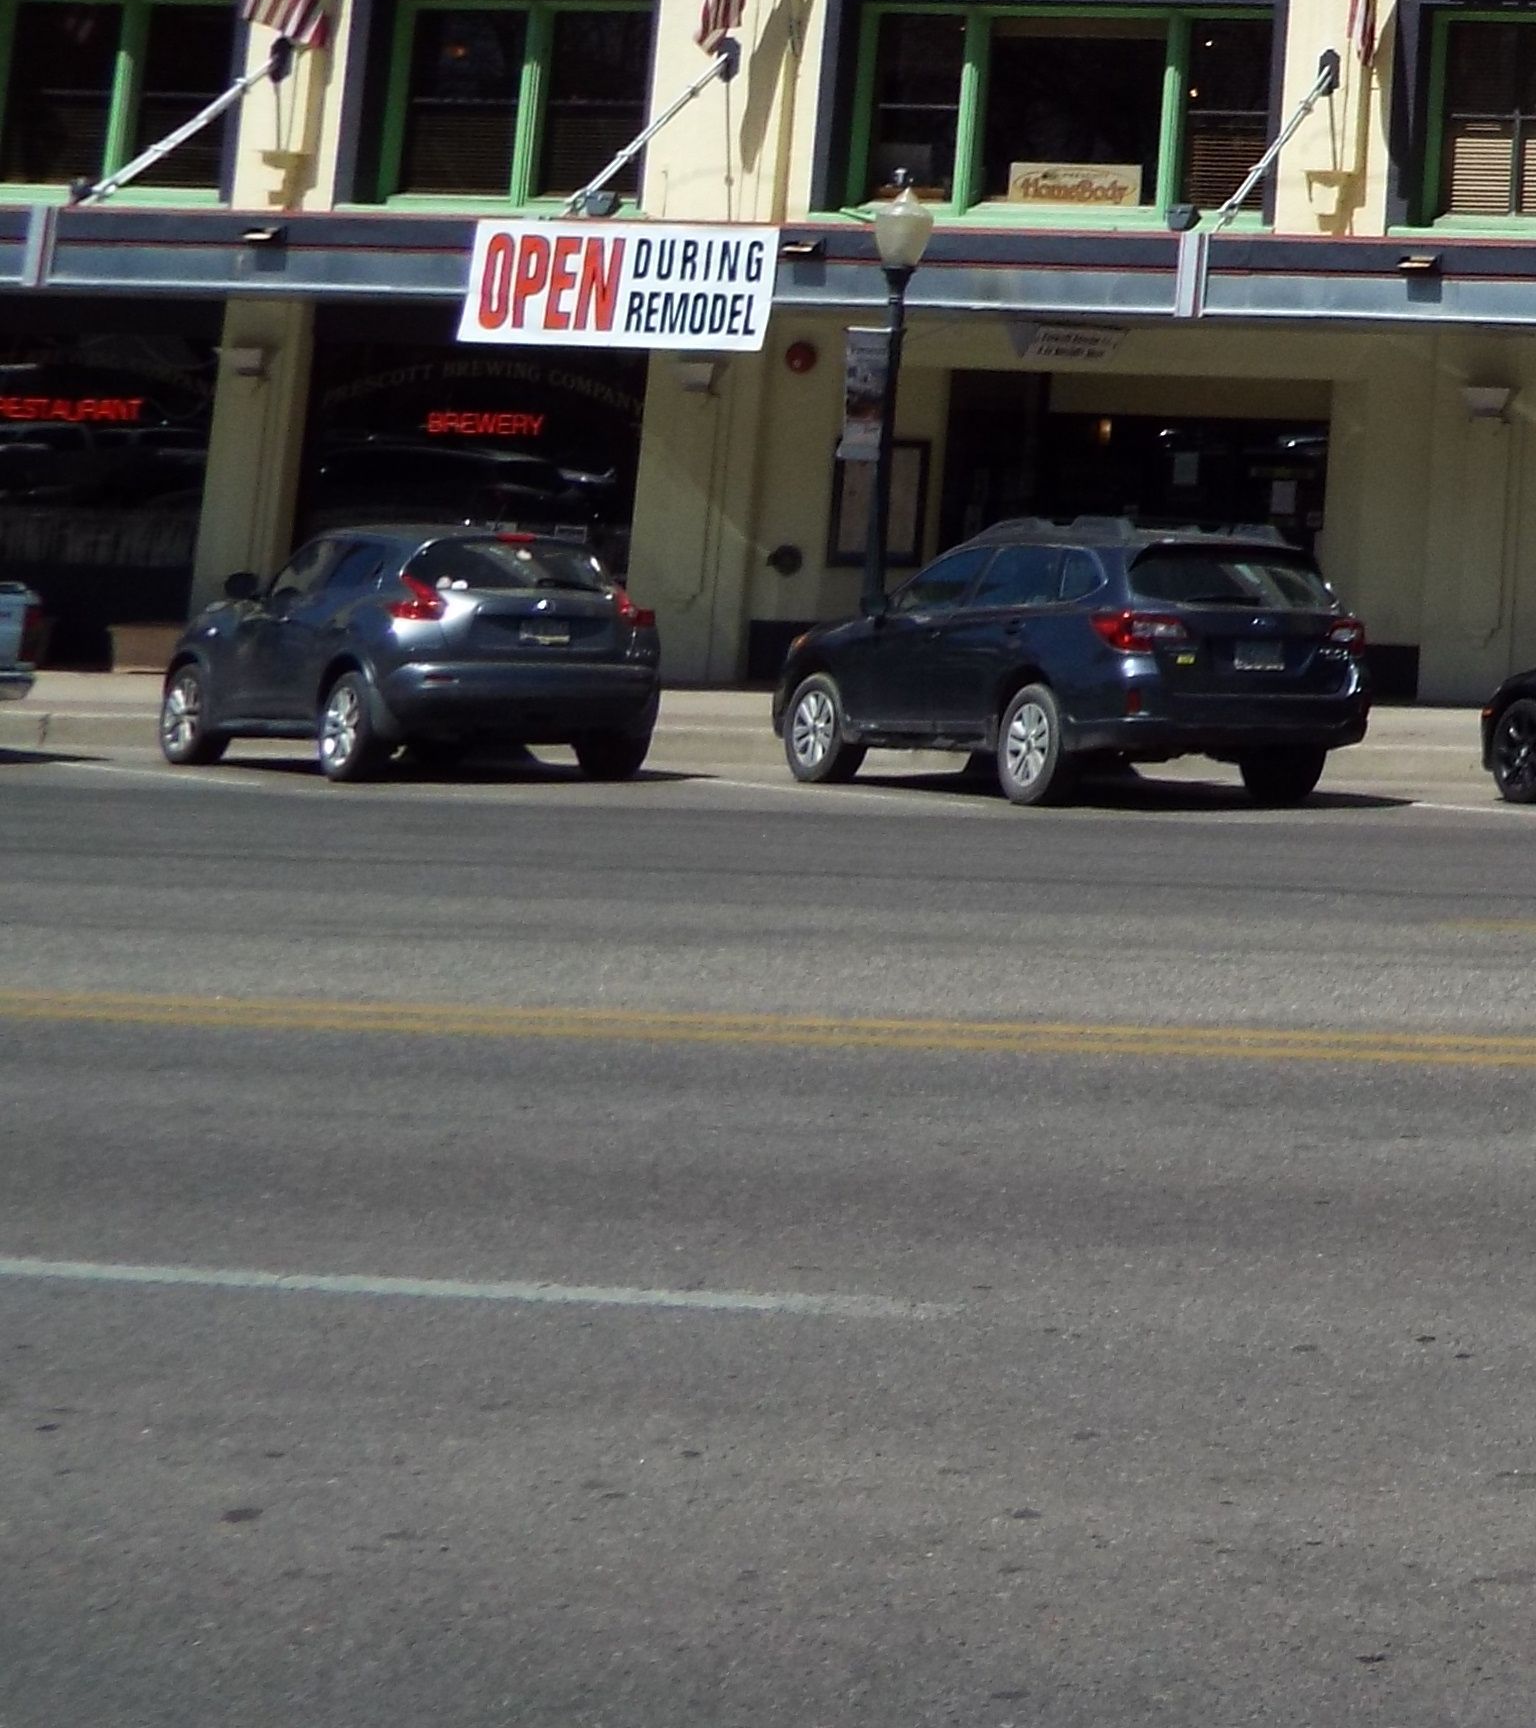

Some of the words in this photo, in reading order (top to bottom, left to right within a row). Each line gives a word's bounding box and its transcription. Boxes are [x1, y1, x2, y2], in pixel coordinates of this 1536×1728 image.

[478, 232, 627, 332] OPEN
[632, 238, 765, 283] DURING
[624, 290, 756, 336] REMODEL
[440, 359, 544, 384] BREWING
[427, 410, 546, 438] BREWERY
